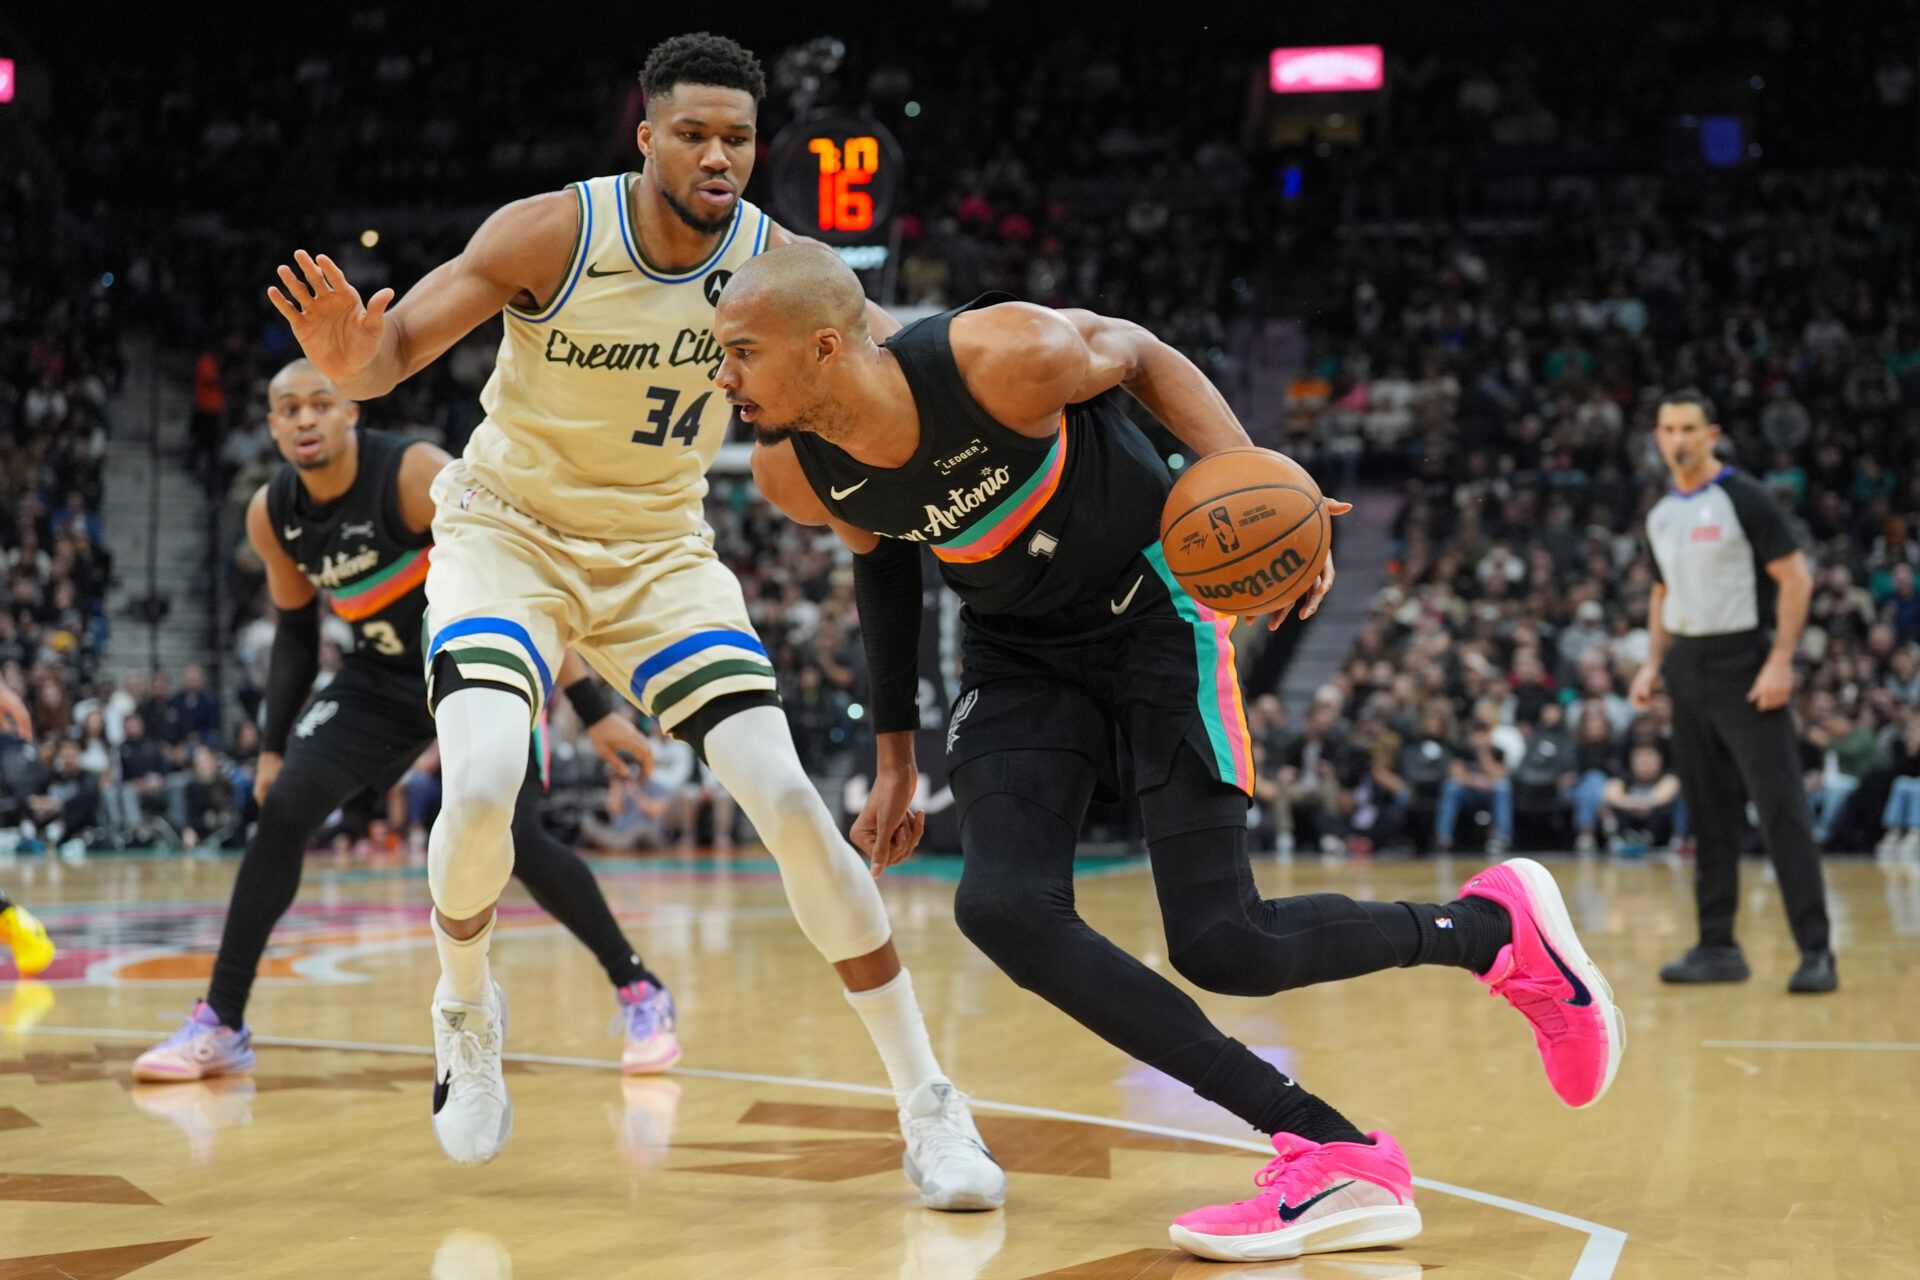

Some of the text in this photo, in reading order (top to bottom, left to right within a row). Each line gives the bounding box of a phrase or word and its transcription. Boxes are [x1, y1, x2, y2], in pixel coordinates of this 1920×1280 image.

[818, 170, 874, 231] 16
[545, 329, 659, 370] Cream
[631, 386, 713, 447] 34
[942, 445, 980, 470] LEDGER
[923, 464, 1011, 537] Antonio
[1194, 547, 1306, 599] Wilson
[362, 620, 404, 656] 3
